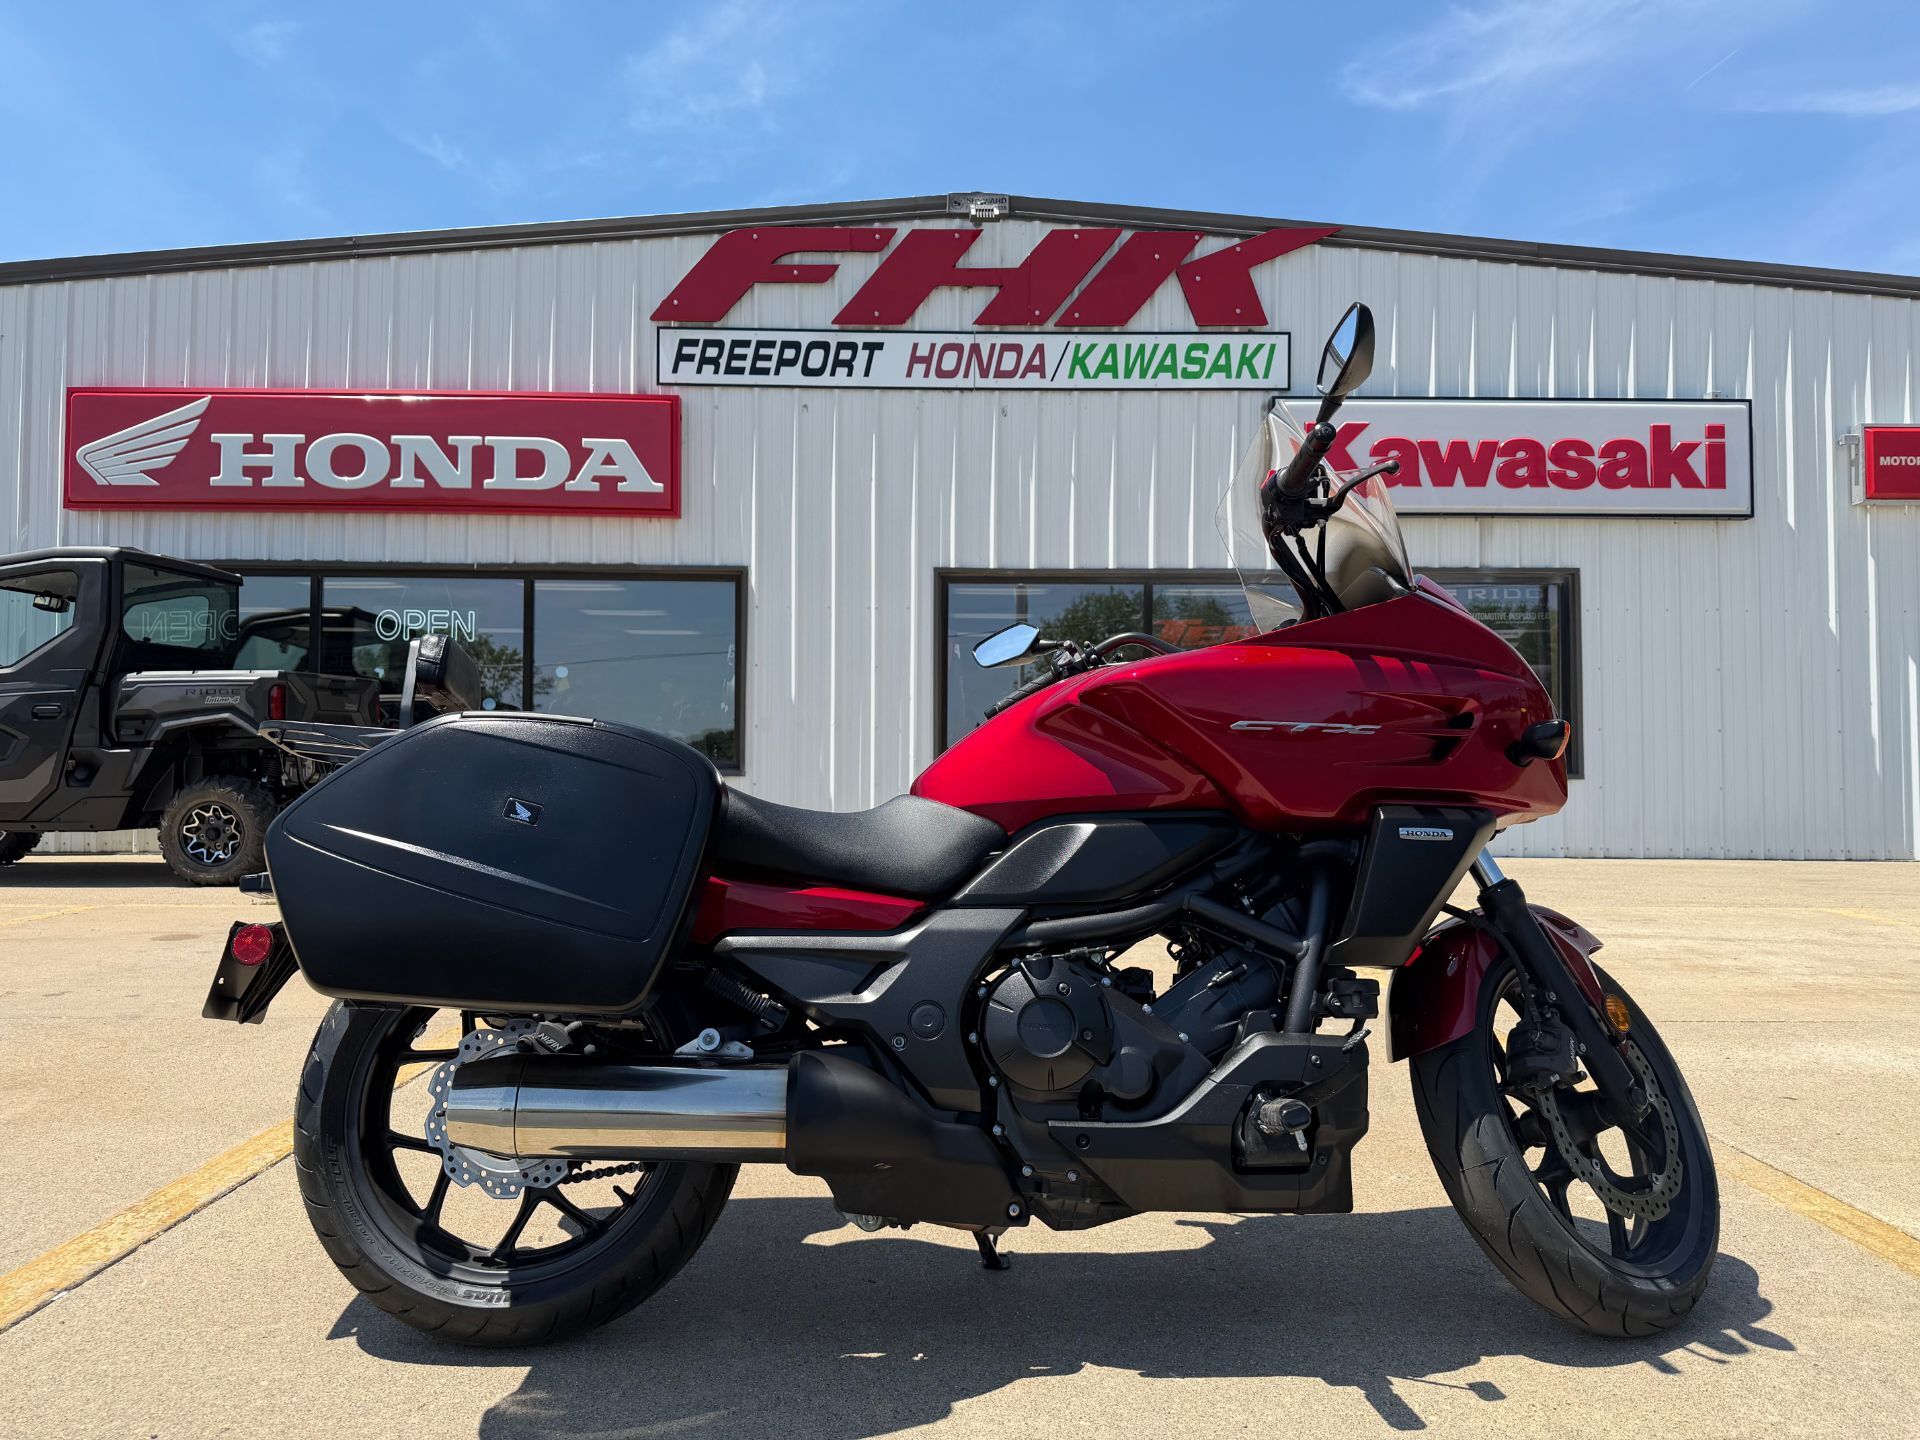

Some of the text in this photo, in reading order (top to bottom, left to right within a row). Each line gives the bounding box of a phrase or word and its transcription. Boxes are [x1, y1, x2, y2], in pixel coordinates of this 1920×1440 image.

[650, 227, 1342, 326] FHK
[671, 338, 884, 378] FREEPORT
[209, 433, 665, 493] HONDA
[1303, 423, 1727, 493] Kawasaki
[375, 609, 475, 642] OPEN
[1229, 720, 1382, 735] CTX
[1406, 830, 1448, 838] HONDA
